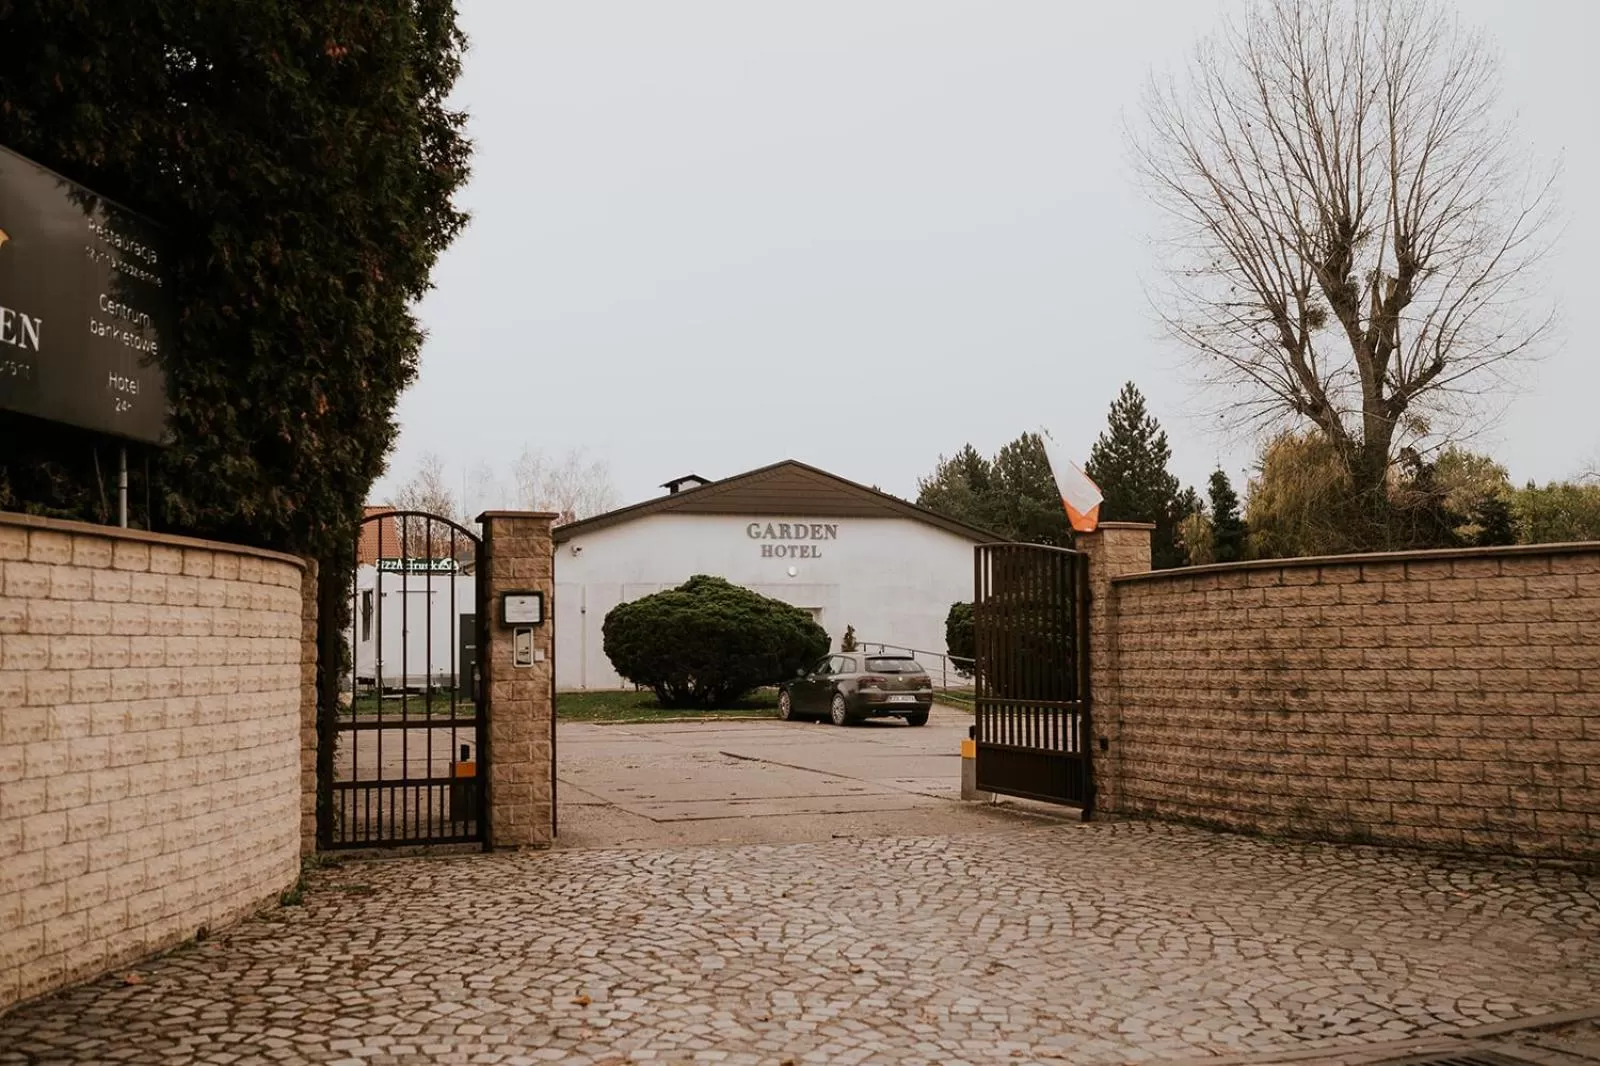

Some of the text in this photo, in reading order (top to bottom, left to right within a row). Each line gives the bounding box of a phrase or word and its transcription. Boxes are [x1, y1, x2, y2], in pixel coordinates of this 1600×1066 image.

[99, 294, 150, 328] Centrum
[108, 371, 140, 395] Hotel
[746, 522, 839, 540] GARDEN
[760, 544, 822, 559] HOTEL
